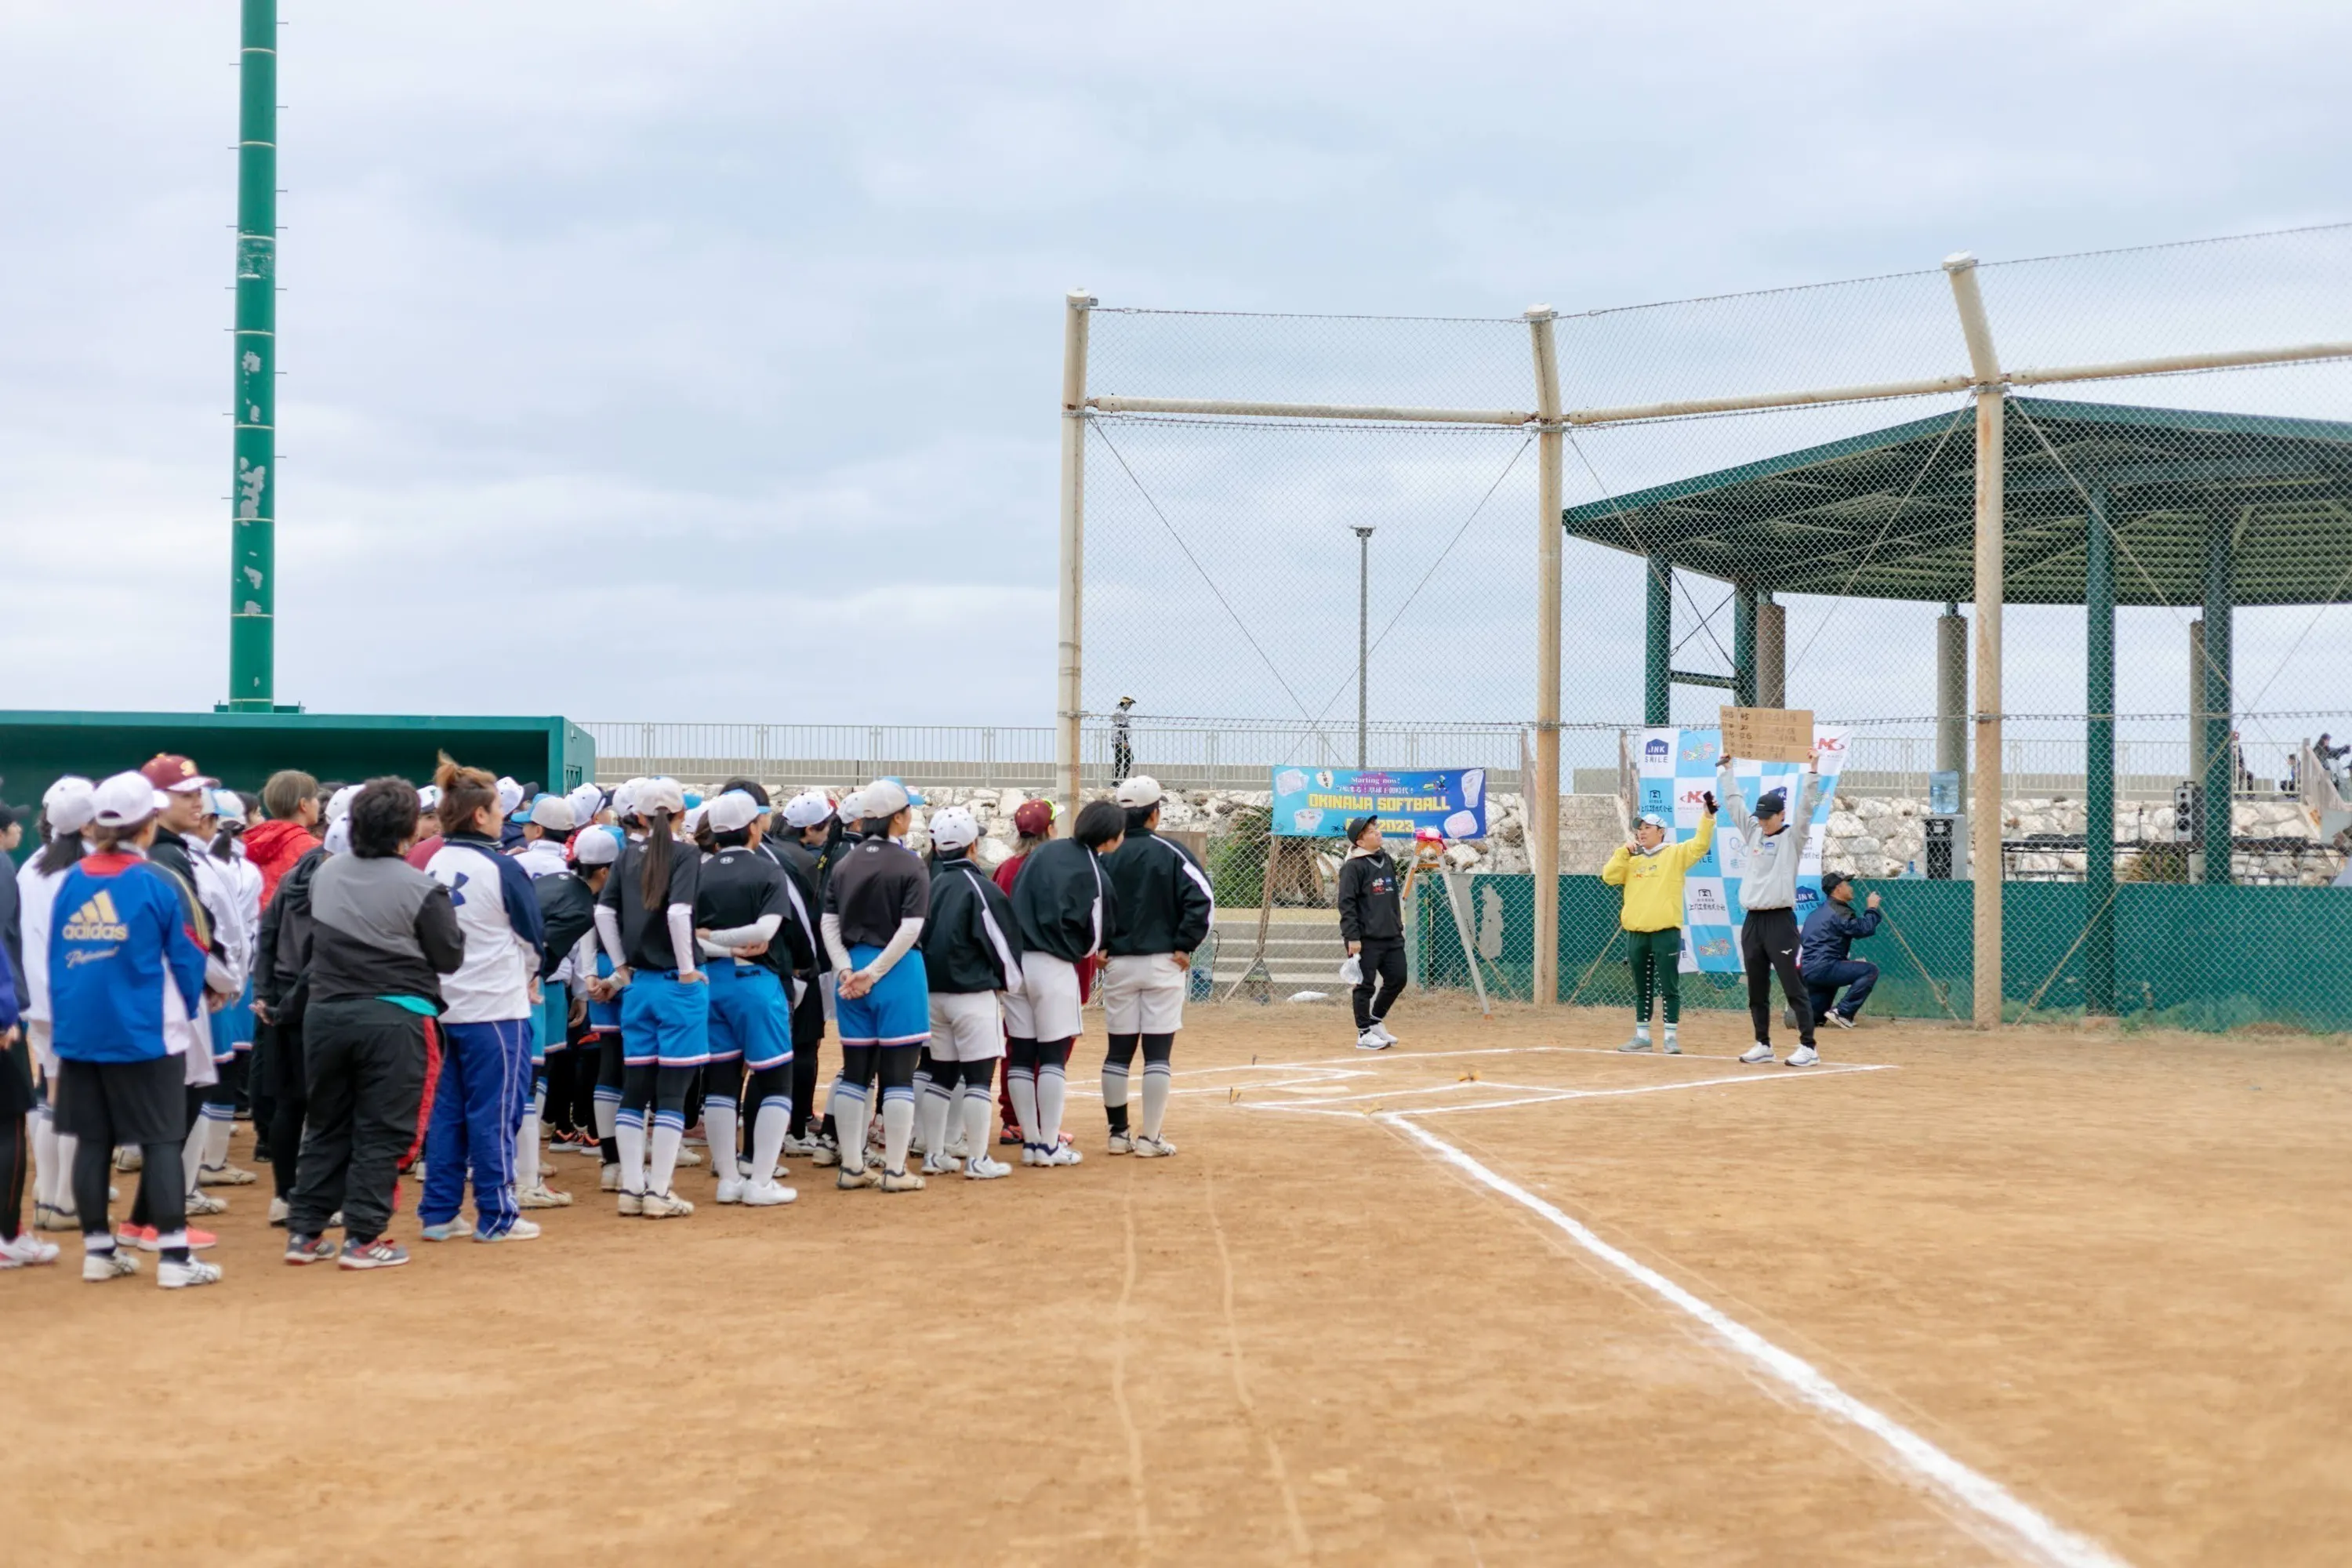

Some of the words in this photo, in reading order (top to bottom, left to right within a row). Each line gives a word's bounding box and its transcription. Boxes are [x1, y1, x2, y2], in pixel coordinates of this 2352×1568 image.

[1351, 776, 1380, 785] Starting
[1308, 793, 1373, 811] OKINAWA
[1377, 796, 1451, 811] SOFTBALL
[1377, 819, 1414, 833] 2023
[62, 922, 129, 941] adidas
